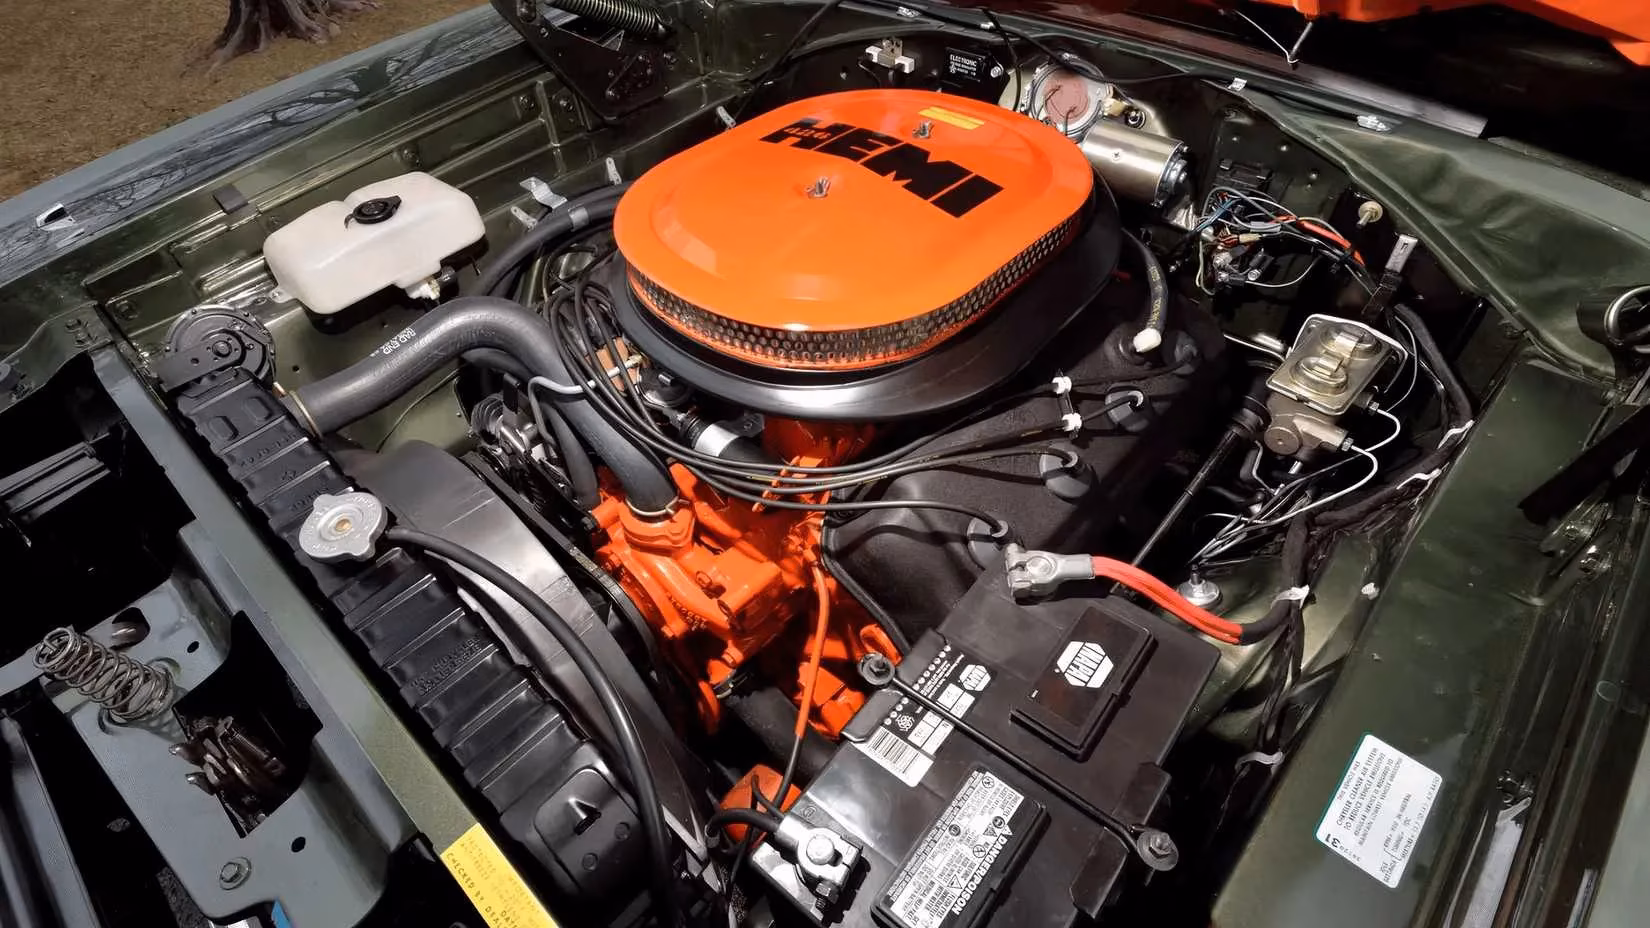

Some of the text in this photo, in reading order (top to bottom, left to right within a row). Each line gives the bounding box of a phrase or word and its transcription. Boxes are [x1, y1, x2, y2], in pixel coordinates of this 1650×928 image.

[759, 118, 1004, 218] HEMI
[445, 851, 476, 889] CHECKED
[950, 834, 1007, 915] DANGER/POISON
